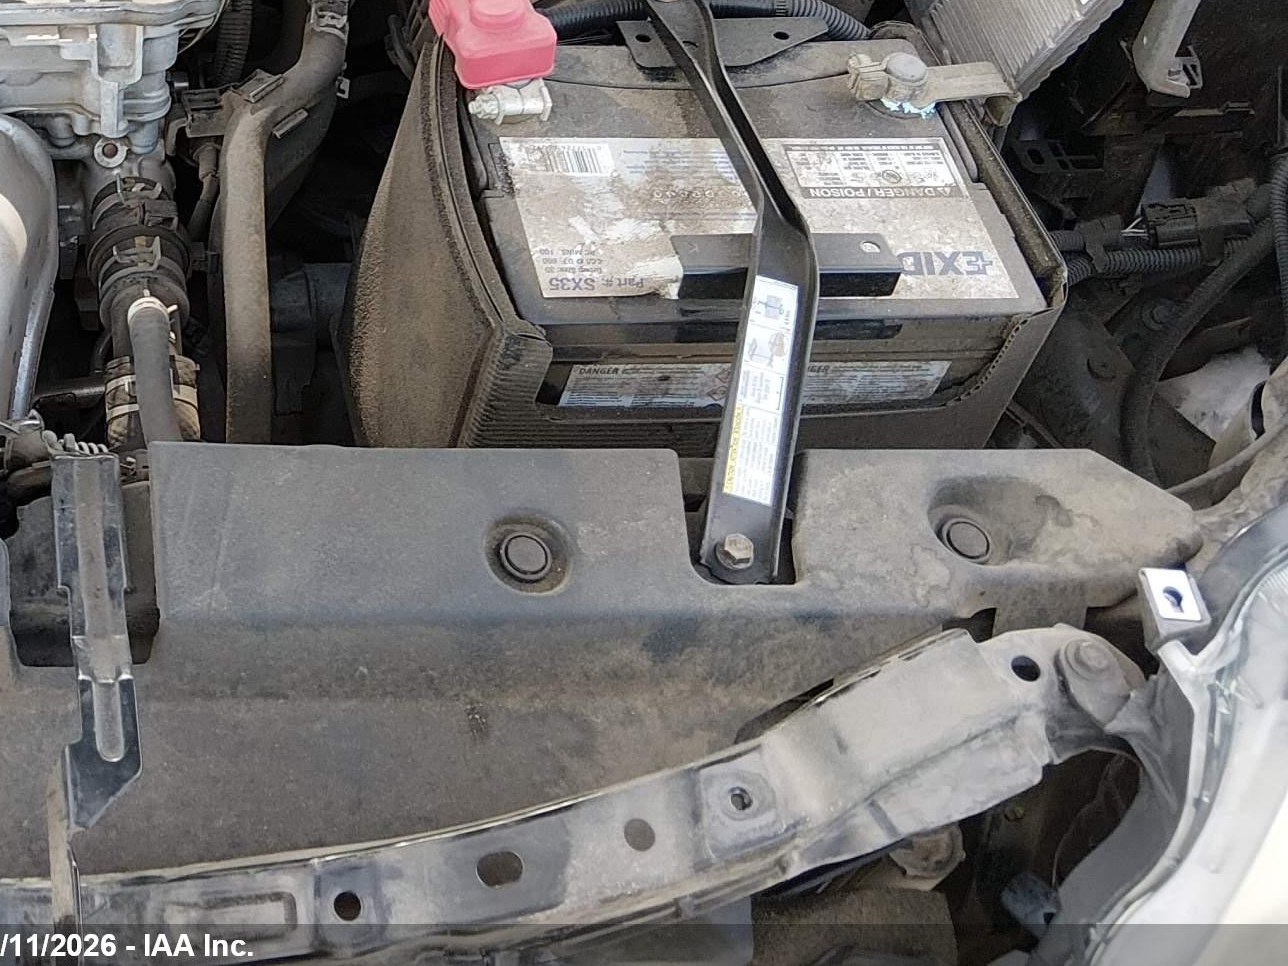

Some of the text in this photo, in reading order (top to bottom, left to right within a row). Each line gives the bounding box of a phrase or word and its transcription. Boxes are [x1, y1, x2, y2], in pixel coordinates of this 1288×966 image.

[809, 187, 866, 197] POISON
[874, 187, 934, 197] DANGER
[895, 251, 994, 276] EXID
[549, 277, 595, 291] SX35
[617, 276, 644, 289] Part
[578, 366, 620, 375] DANGER
